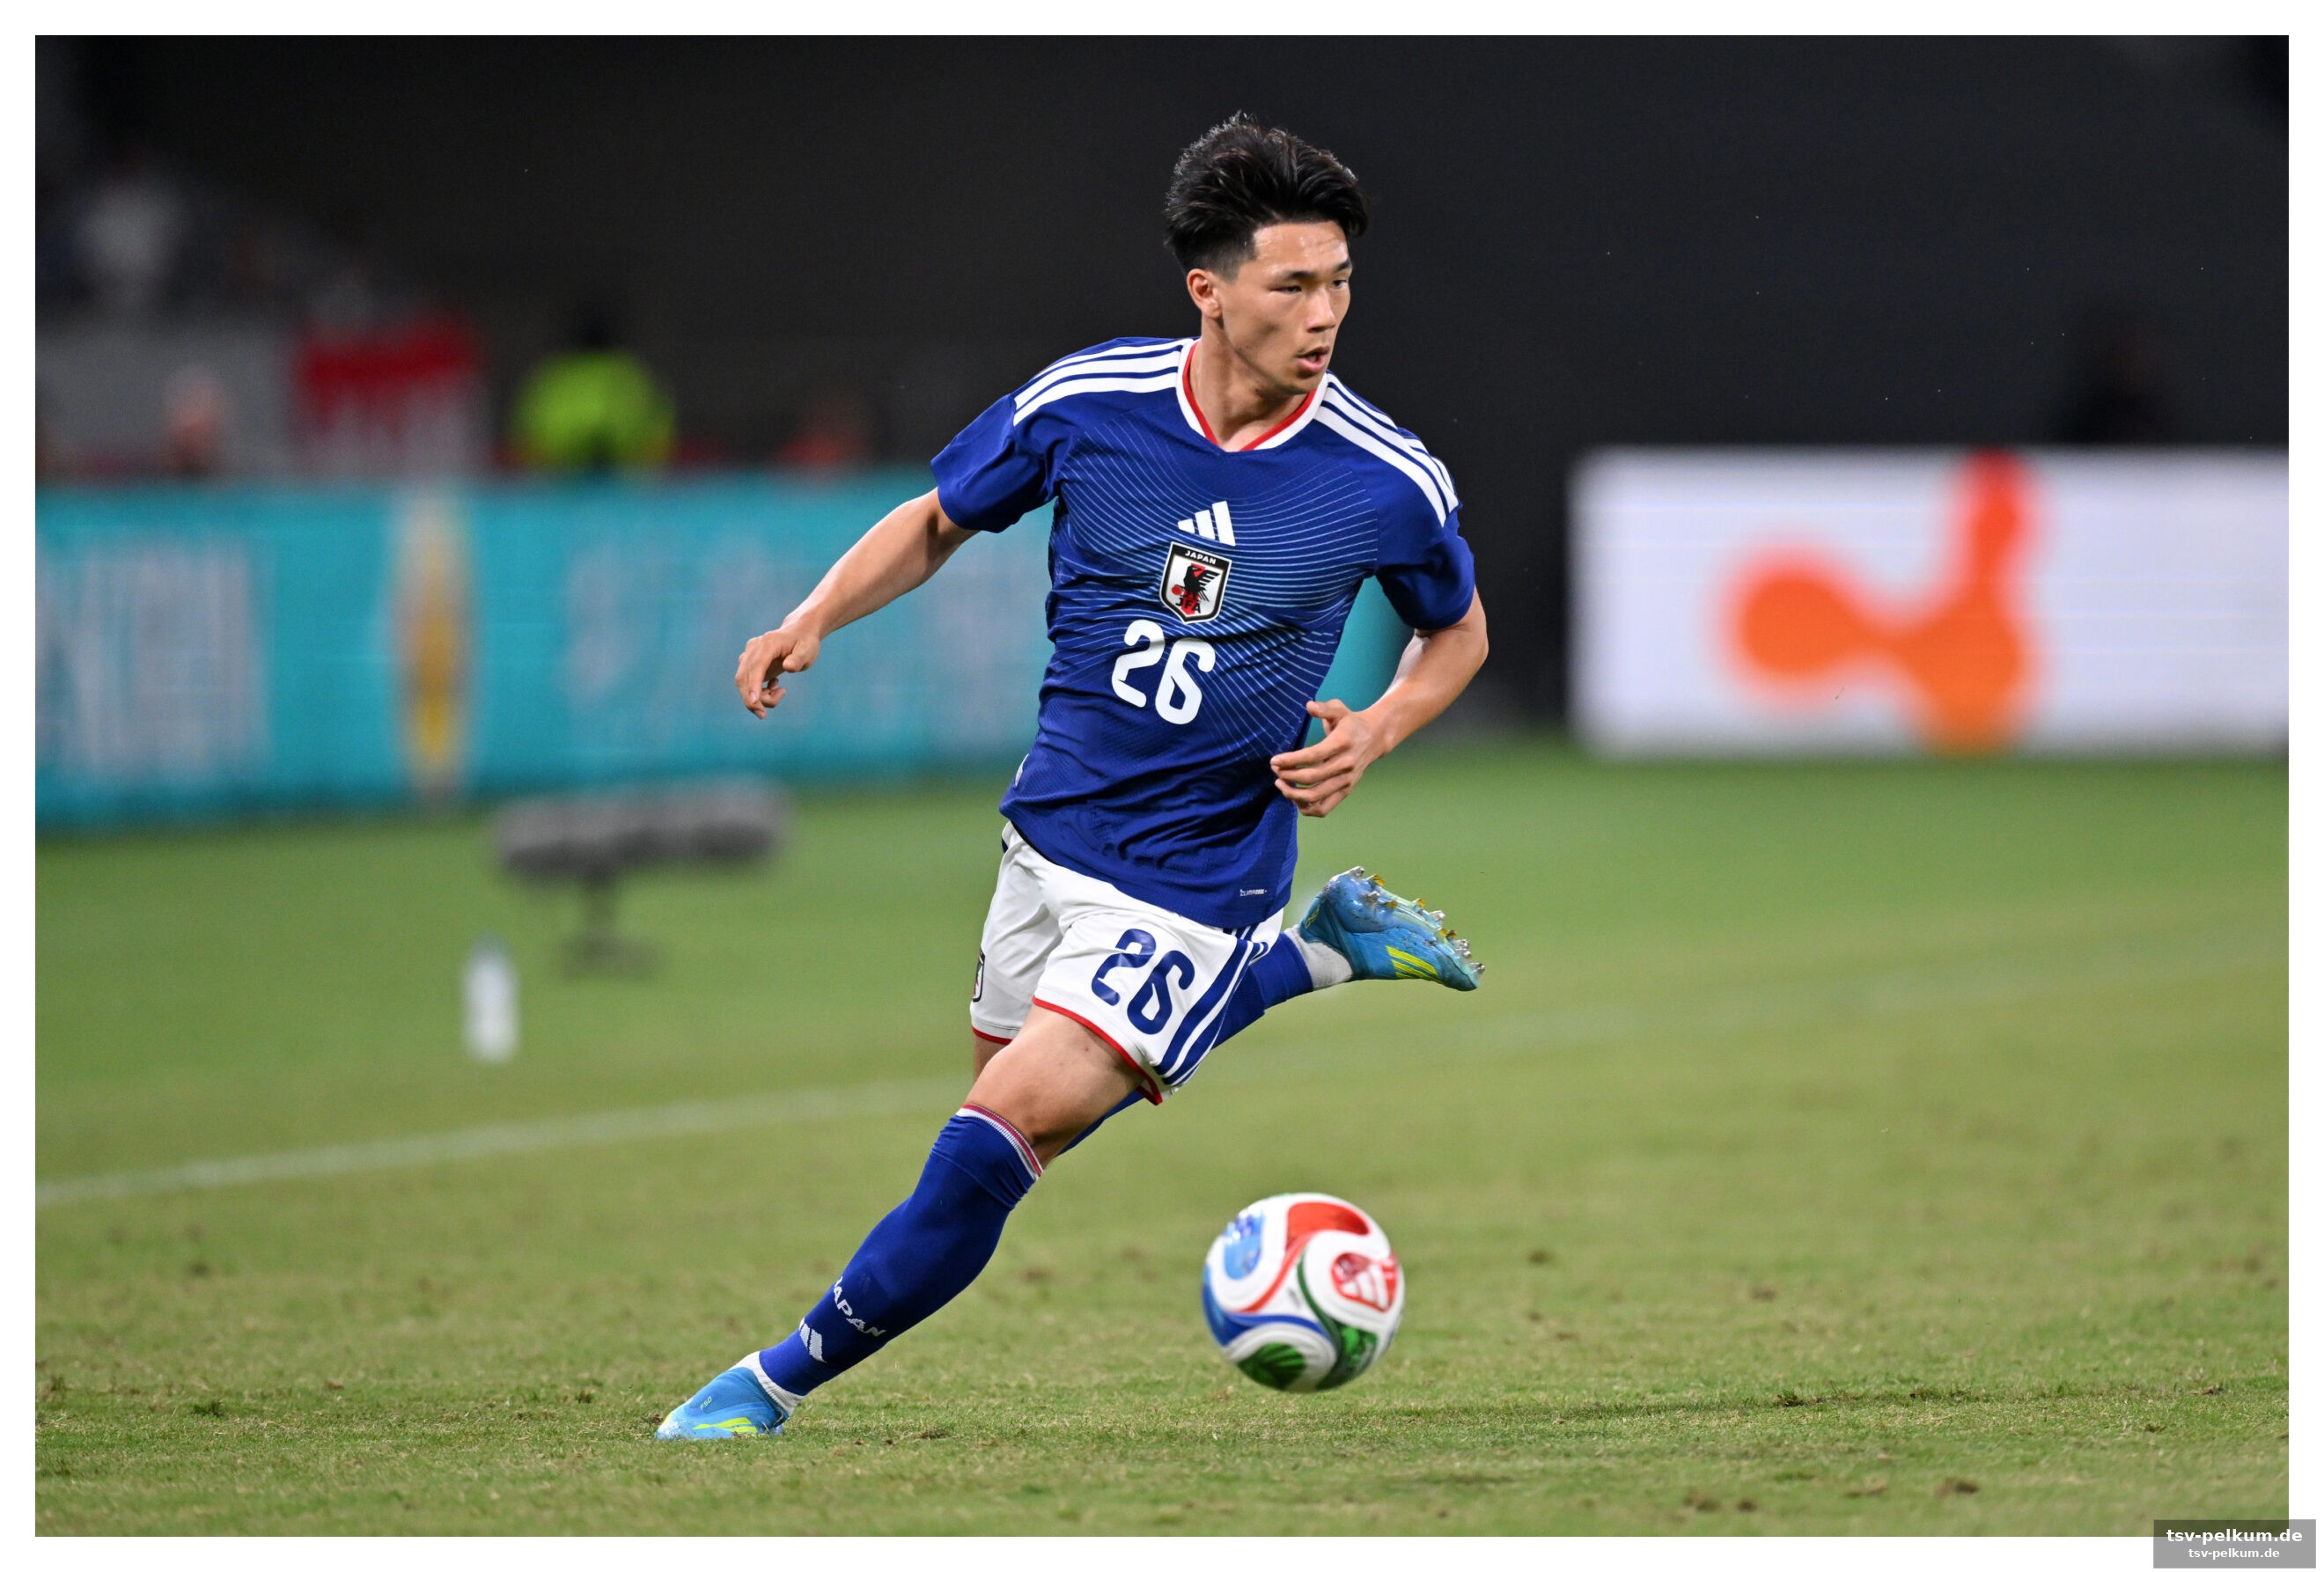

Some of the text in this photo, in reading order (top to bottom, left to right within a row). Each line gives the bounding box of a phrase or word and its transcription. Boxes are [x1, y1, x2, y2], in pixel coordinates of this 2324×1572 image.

[1185, 550, 1217, 564] JAPAN
[1175, 598, 1201, 613] JFA
[1111, 619, 1216, 724] 26
[1091, 928, 1195, 1035] 26
